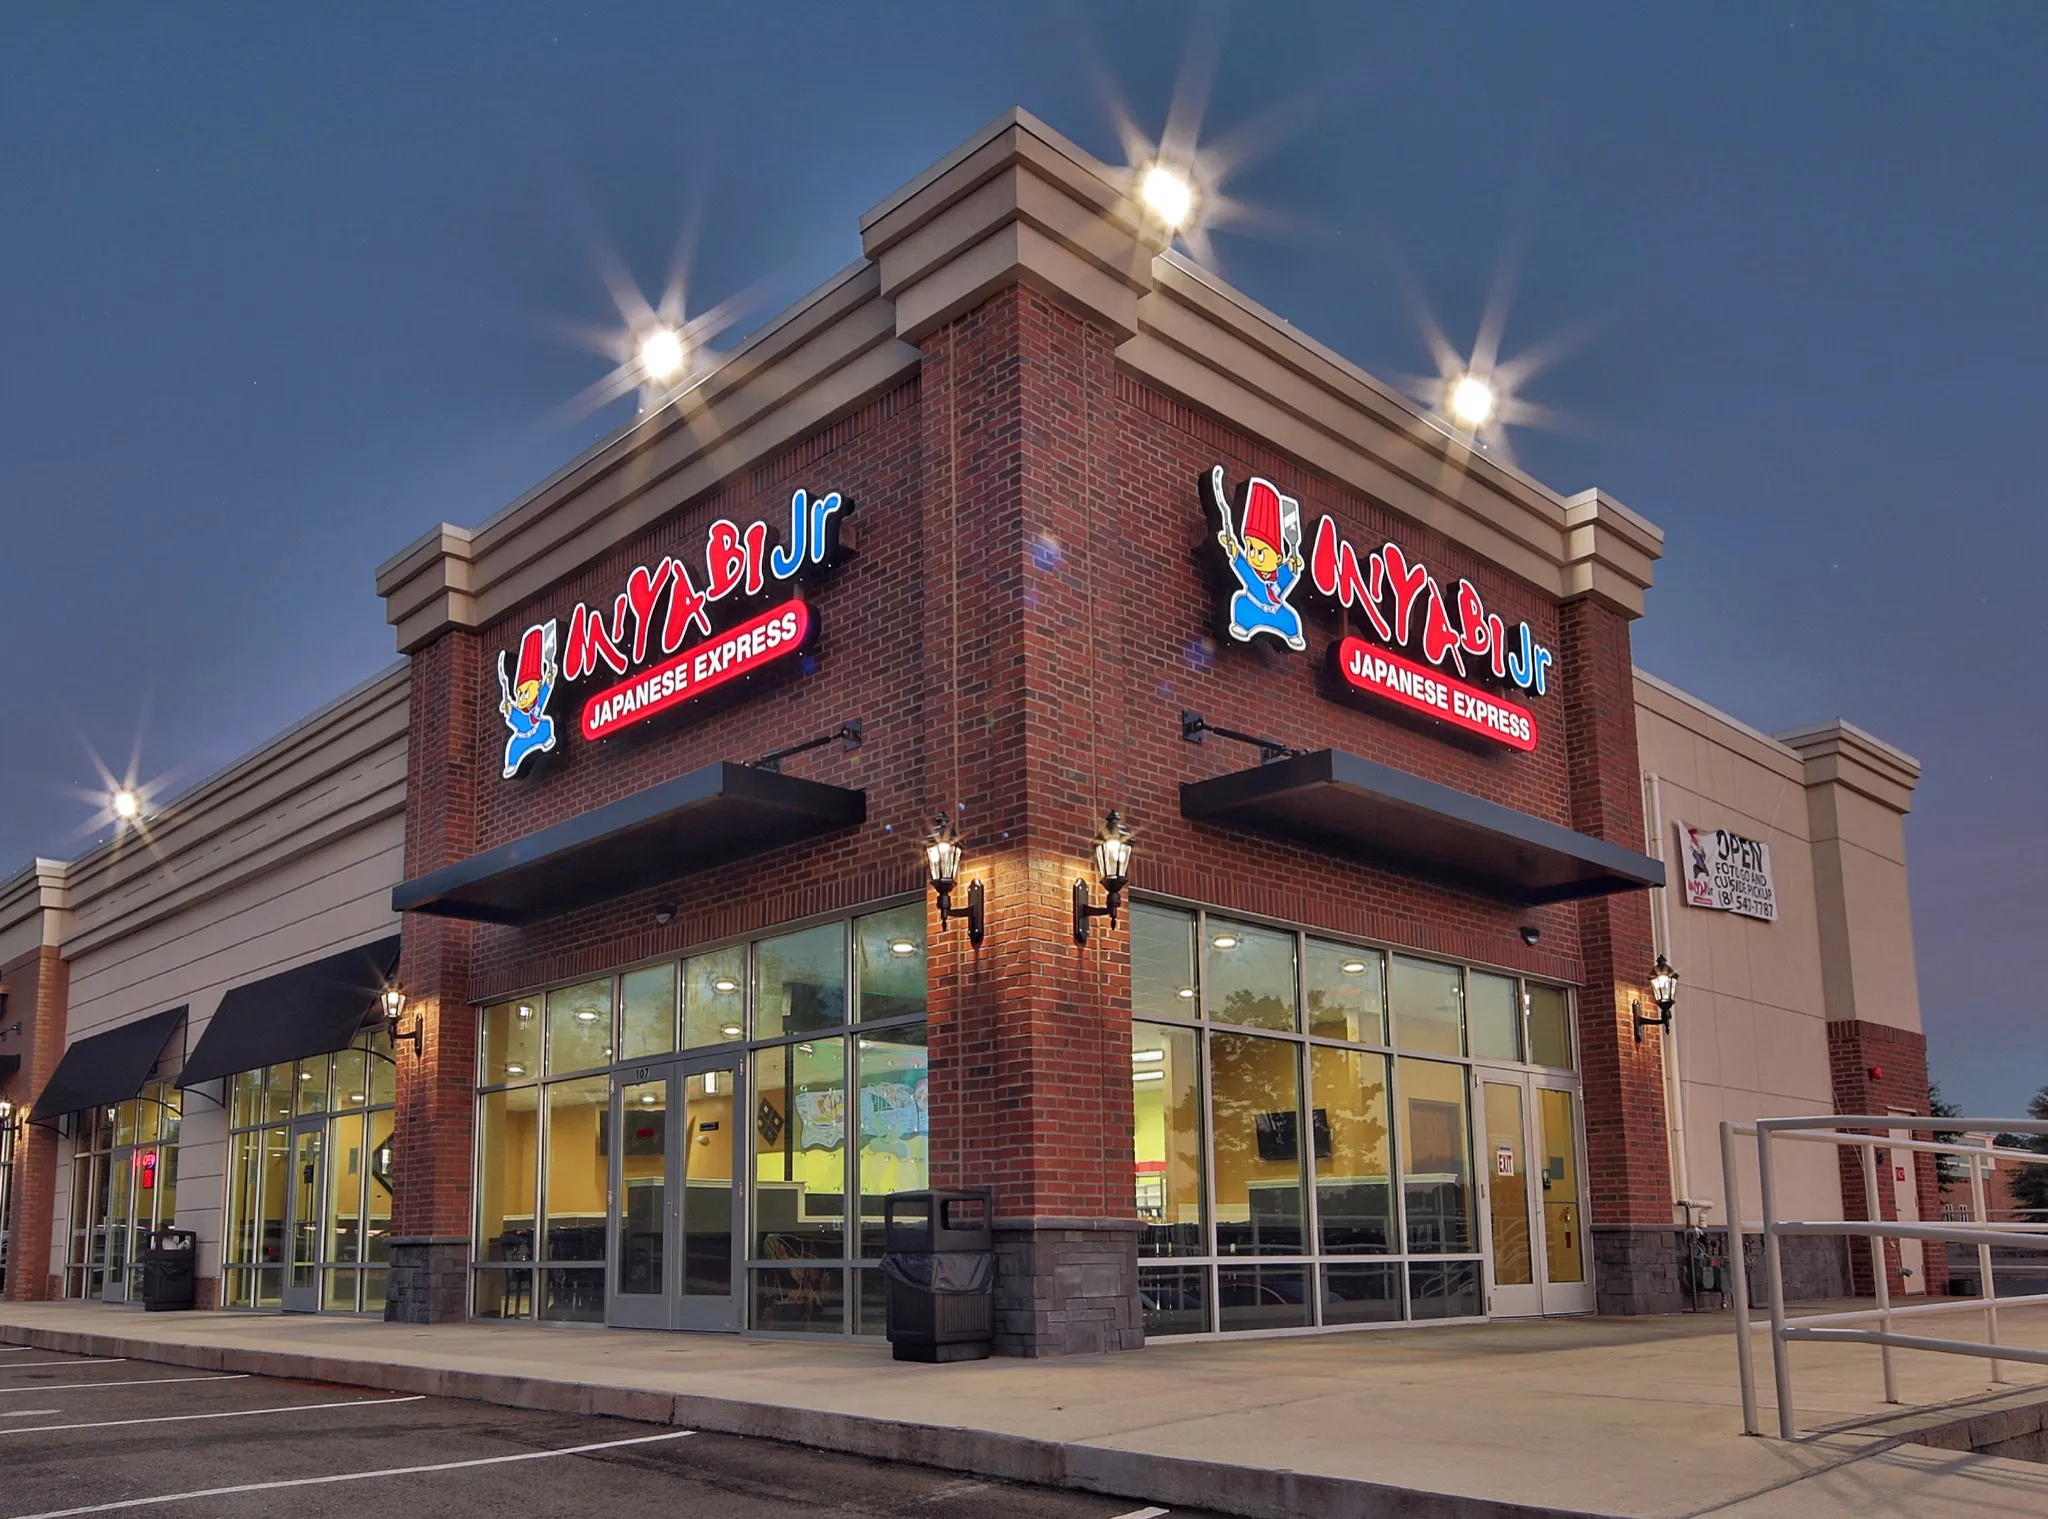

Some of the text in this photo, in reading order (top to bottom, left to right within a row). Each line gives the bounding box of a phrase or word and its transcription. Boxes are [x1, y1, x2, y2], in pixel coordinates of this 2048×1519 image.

[564, 489, 842, 681] MIYABI Jr
[1311, 514, 1552, 696] MIYABI Jr
[589, 612, 797, 730] JAPANESE EXPRESS
[1349, 650, 1530, 741] JAPANESE EXPRESS
[1716, 829, 1763, 873] OPEN
[1714, 876, 1747, 895] CUSIDE
[1715, 862, 1730, 875] FO
[1751, 872, 1767, 887] AND
[636, 1068, 649, 1079] 107
[1498, 1153, 1512, 1173] EXIT
